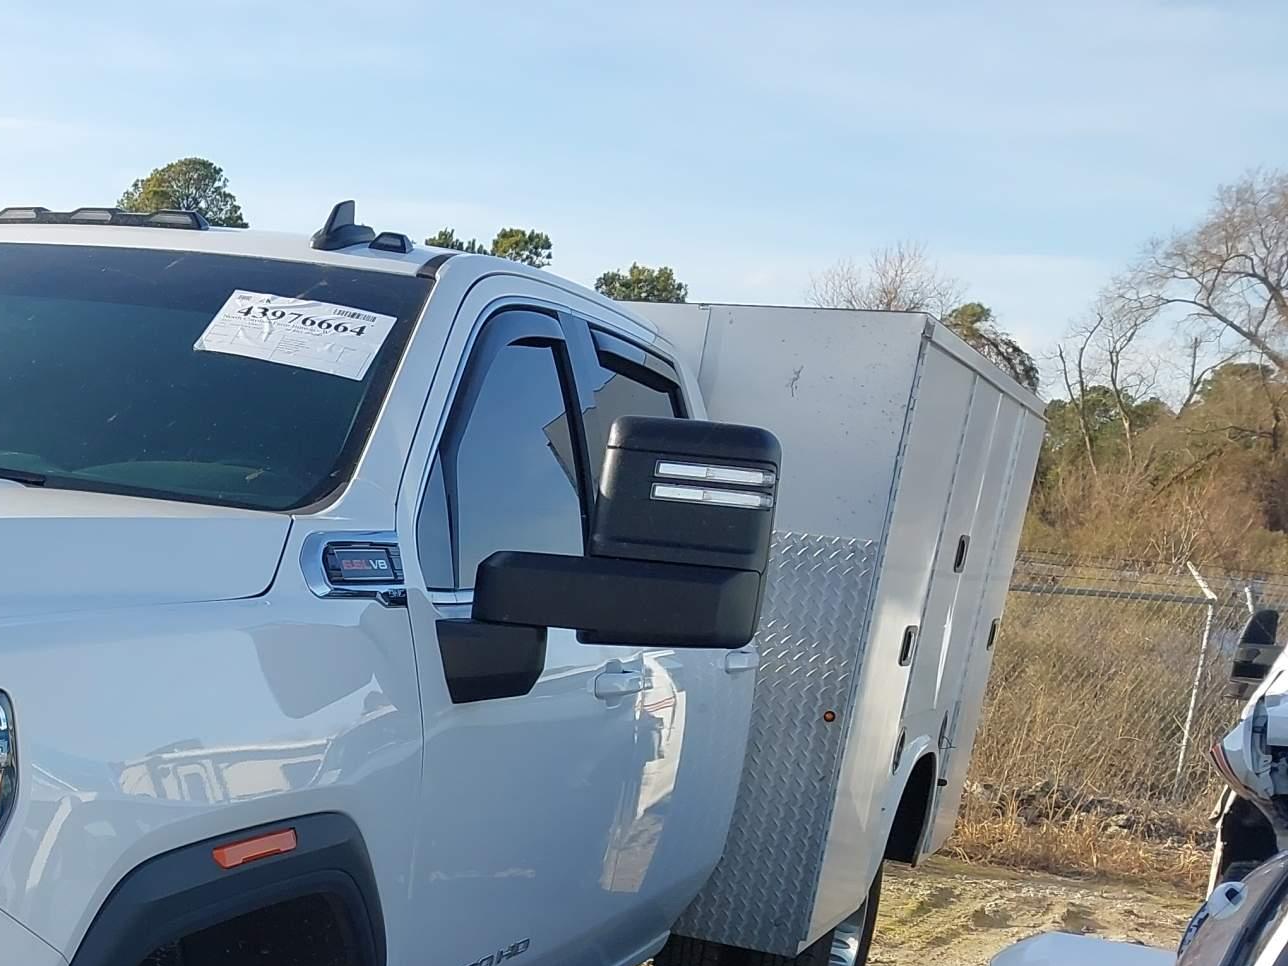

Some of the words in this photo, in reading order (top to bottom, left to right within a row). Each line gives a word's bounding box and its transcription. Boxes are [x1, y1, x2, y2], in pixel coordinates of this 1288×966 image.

[237, 305, 367, 337] 43976664
[369, 559, 388, 570] V8
[495, 938, 530, 966] HD
